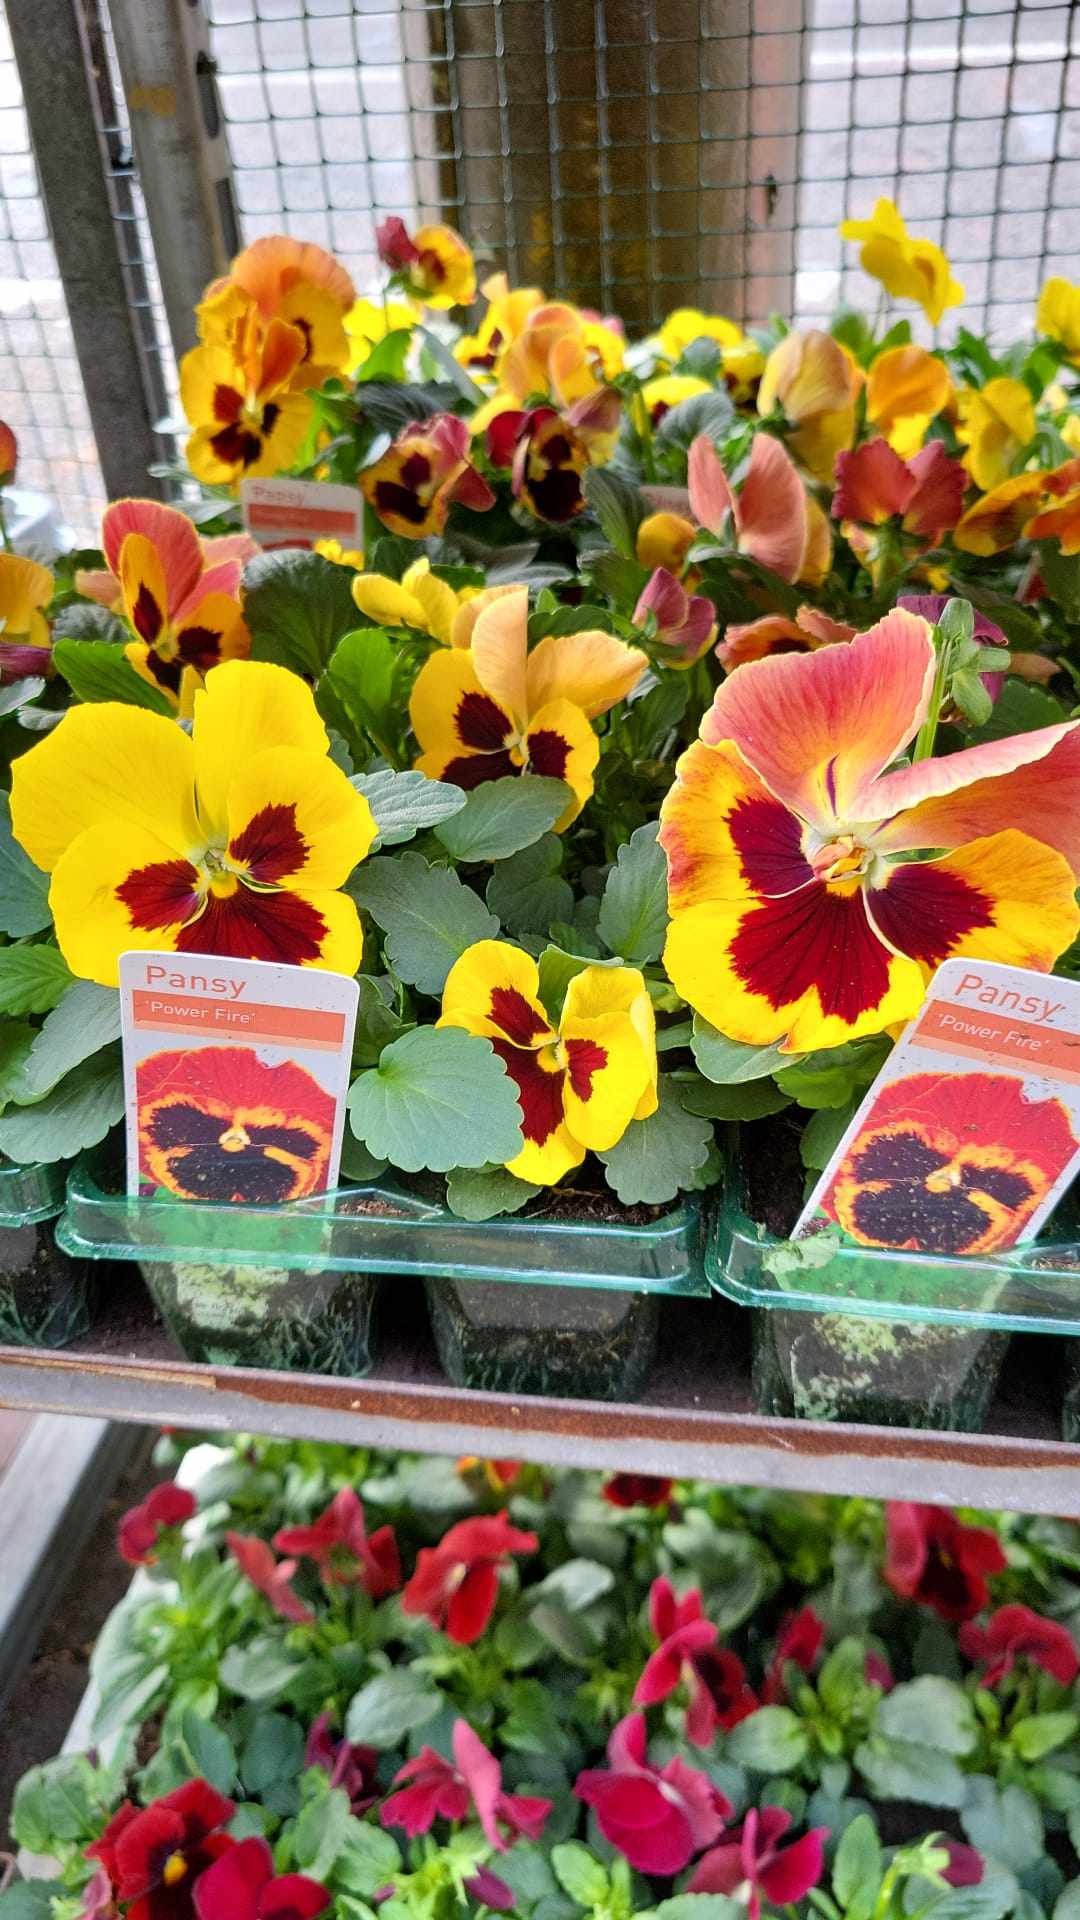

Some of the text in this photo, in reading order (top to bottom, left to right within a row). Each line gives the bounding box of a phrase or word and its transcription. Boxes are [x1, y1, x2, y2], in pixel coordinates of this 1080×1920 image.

[146, 964, 247, 999] Pansy
[954, 974, 1062, 1022] Pansy
[145, 1000, 256, 1025] 'Power Fire'
[938, 1013, 1050, 1051] 'Power Fire'
